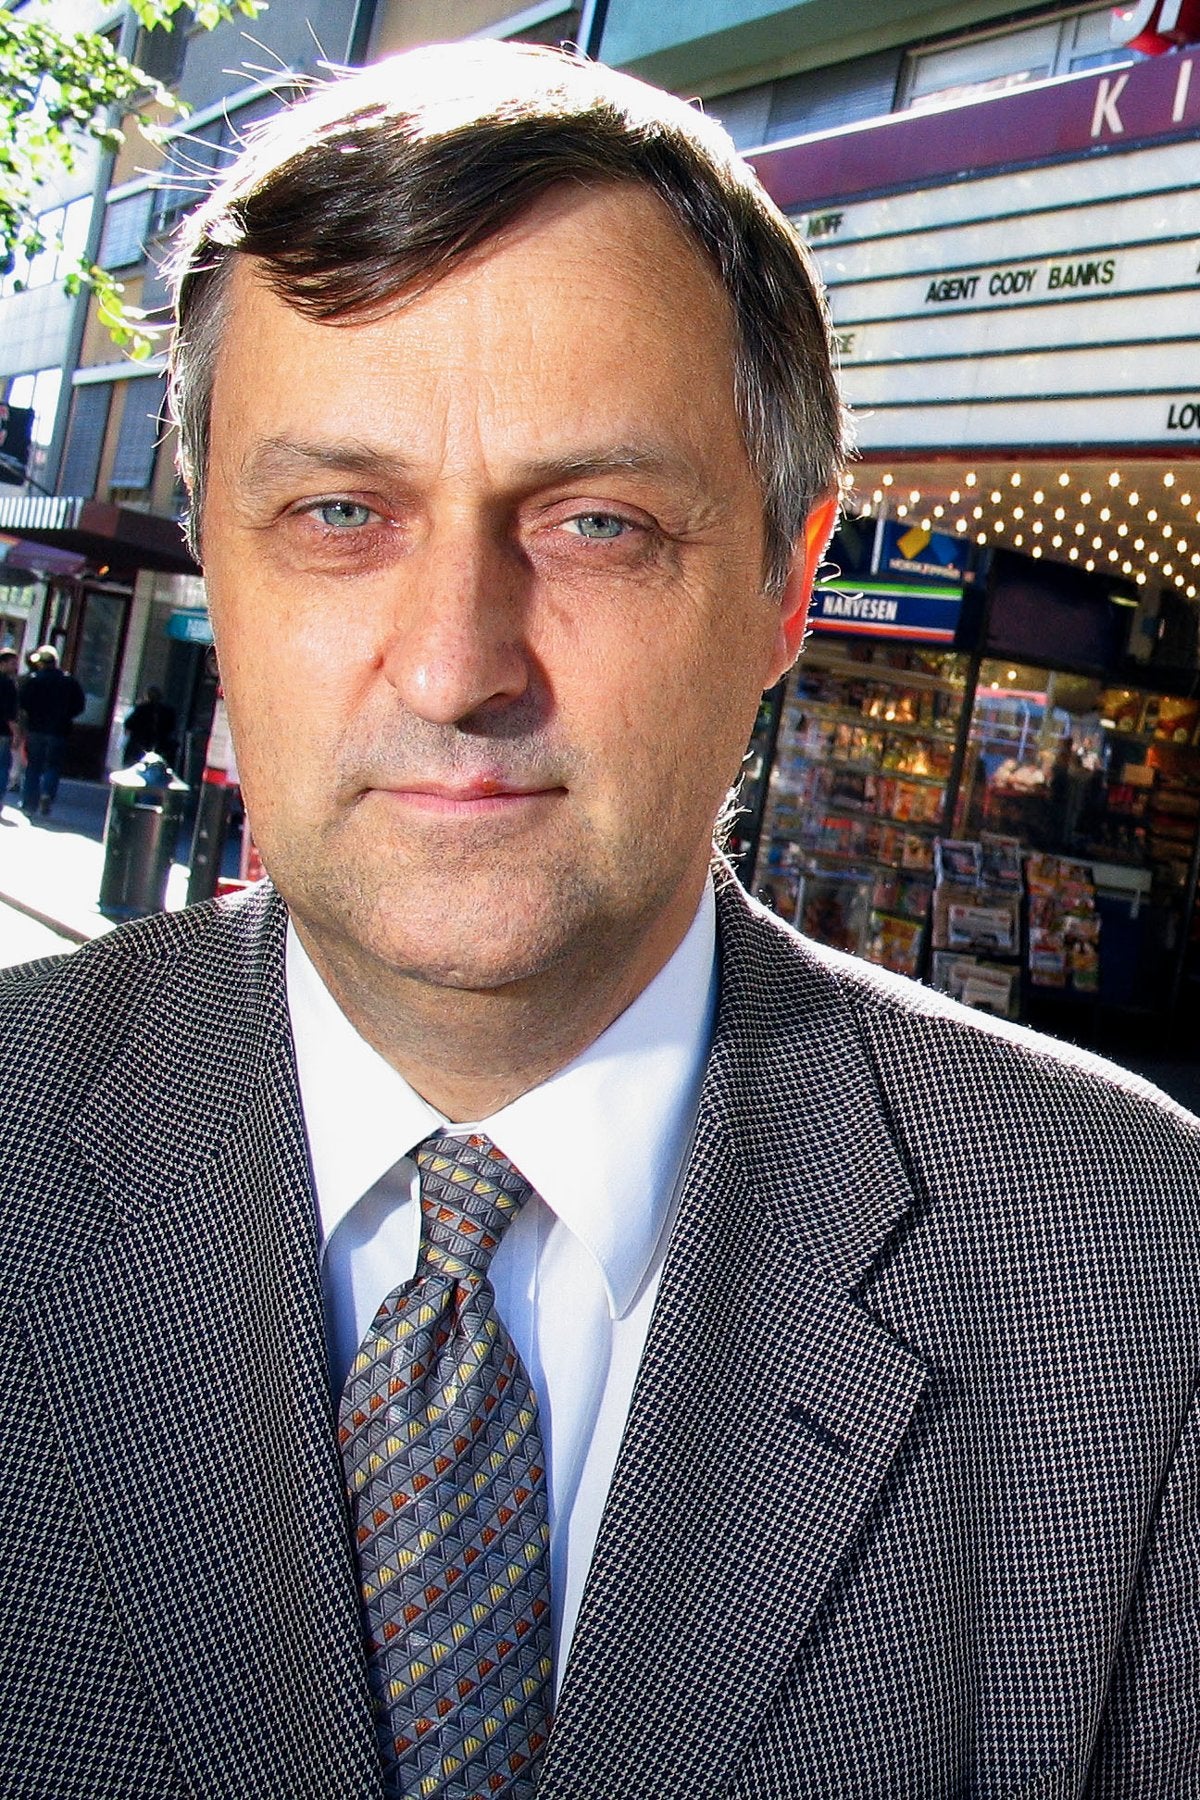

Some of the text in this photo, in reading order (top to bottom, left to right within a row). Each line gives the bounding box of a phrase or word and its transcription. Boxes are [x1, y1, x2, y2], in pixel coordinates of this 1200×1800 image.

[925, 259, 1117, 303] AGENT CODY BANKS
[822, 595, 898, 621] NARVESEN
